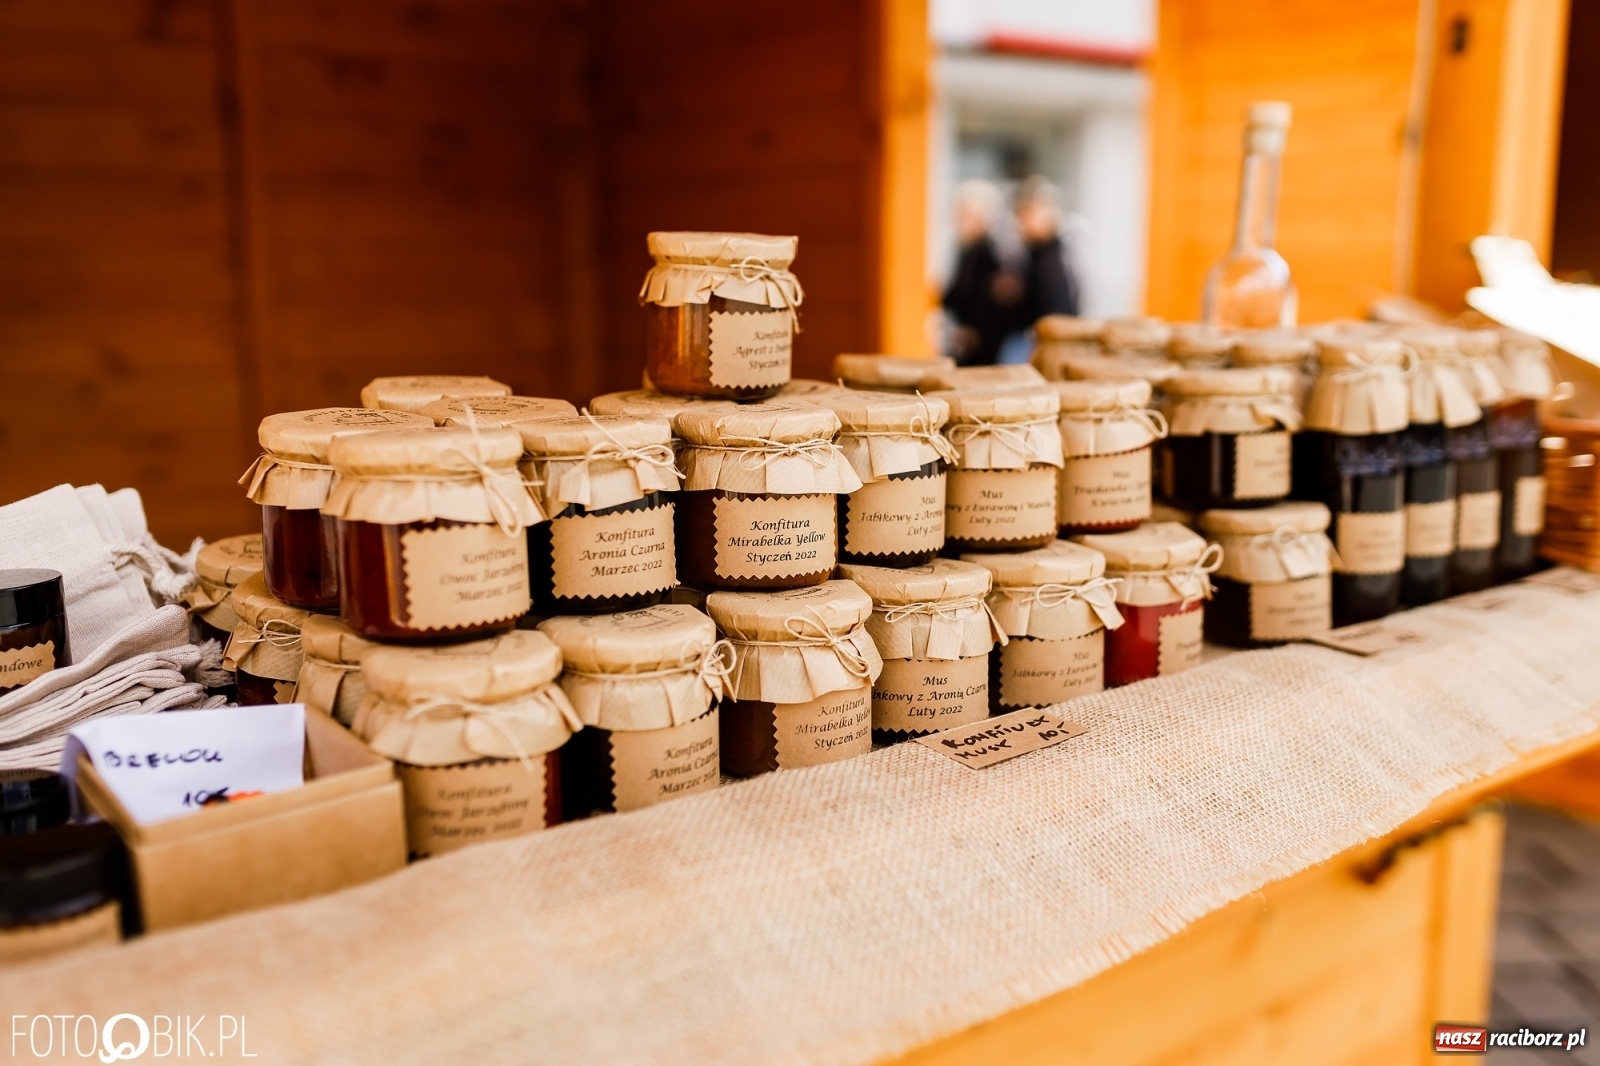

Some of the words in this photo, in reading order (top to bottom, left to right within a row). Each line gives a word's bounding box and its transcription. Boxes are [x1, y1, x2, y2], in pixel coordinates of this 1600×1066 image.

[920, 496, 936, 506] Mus
[979, 490, 1003, 499] Mus
[750, 518, 810, 534] Konfitura
[969, 515, 992, 526] Luty
[594, 527, 655, 545] Konfitura
[727, 534, 792, 547] Mirabelka
[796, 531, 826, 546] Yellow
[906, 526, 929, 537] Luty
[579, 548, 627, 561] Aronia
[630, 541, 665, 556] Czarna
[745, 550, 792, 566] Styczeń
[795, 550, 817, 560] 2022
[590, 564, 639, 577] Marzec
[641, 559, 663, 572] 2022
[1072, 652, 1089, 662] Mus
[922, 676, 948, 686] Mus
[1063, 677, 1082, 688] Luty
[926, 688, 964, 701] Aronią
[817, 697, 865, 717] Konfitura
[907, 706, 936, 719] Luty
[939, 705, 963, 715] 2022
[794, 715, 853, 735] Mirabelka
[662, 737, 713, 760] Konfitura
[813, 732, 854, 751] Styczeń
[646, 763, 692, 780] Aronia
[657, 775, 702, 796] Marzec
